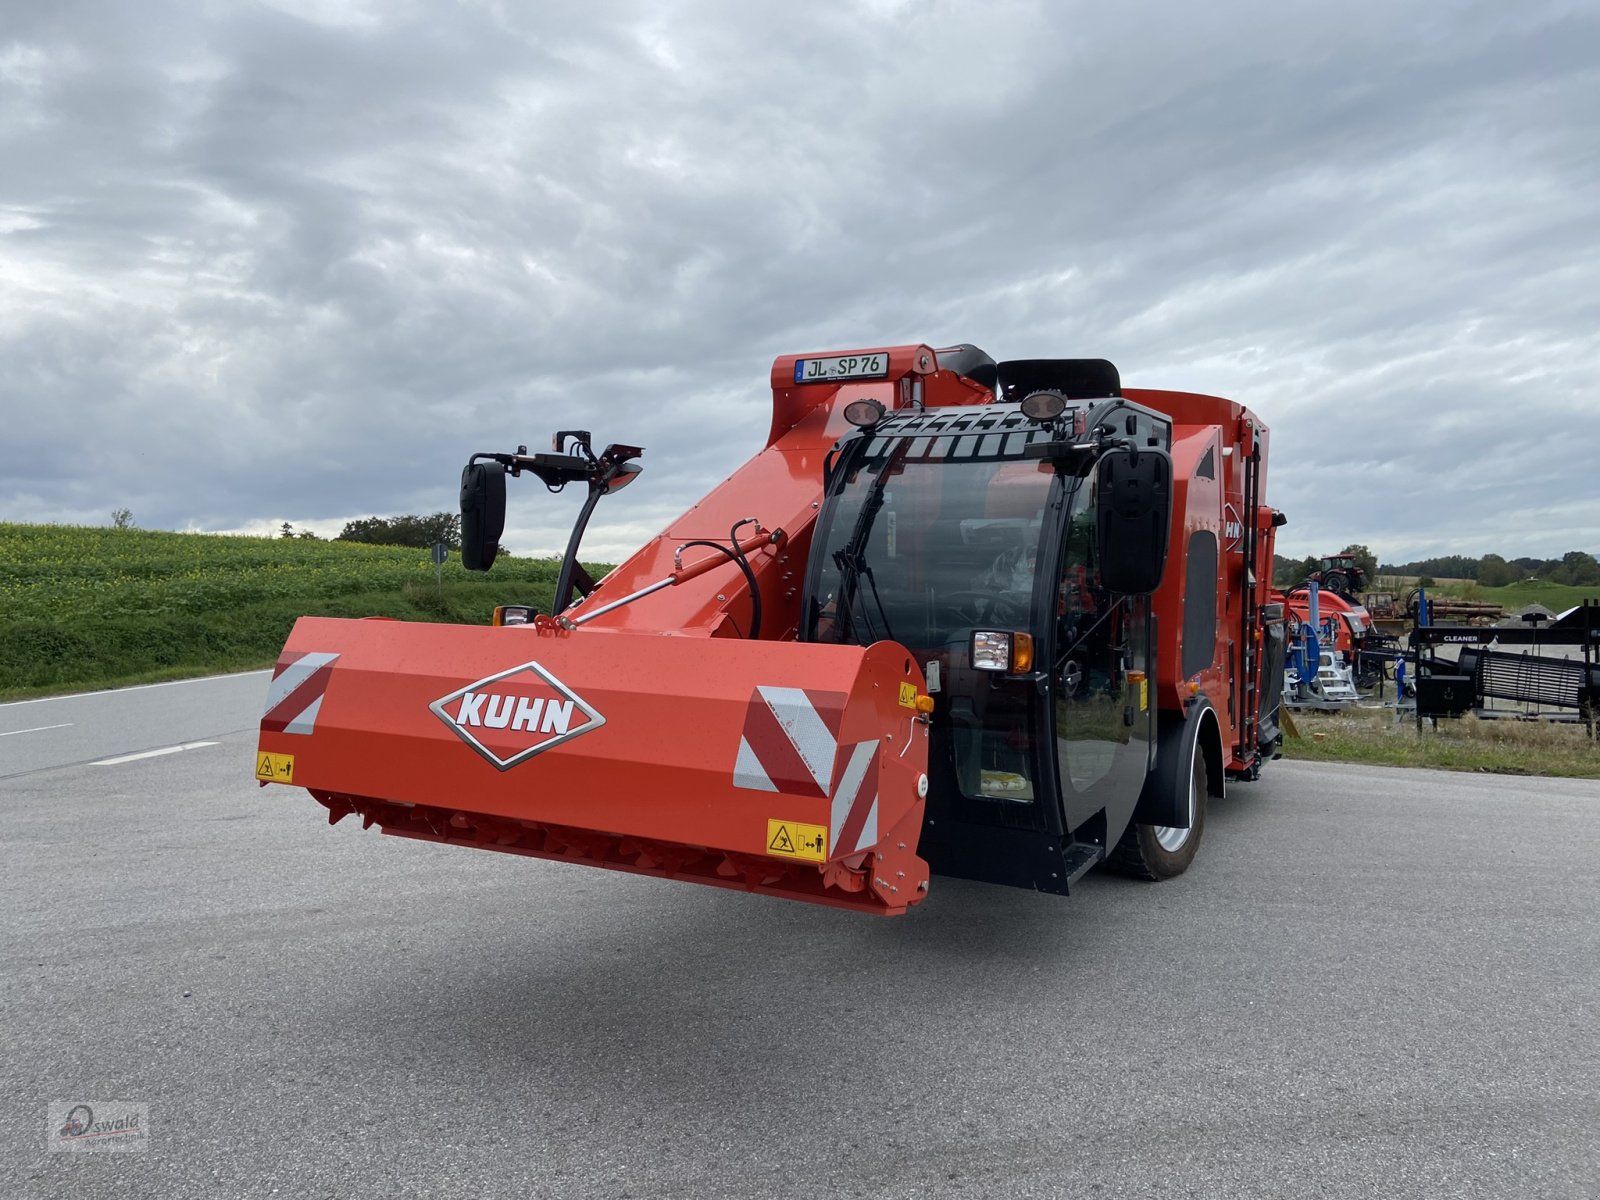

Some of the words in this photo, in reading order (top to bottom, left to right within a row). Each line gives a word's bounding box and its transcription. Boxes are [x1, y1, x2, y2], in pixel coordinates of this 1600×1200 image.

[808, 361, 827, 377] JL
[838, 358, 858, 375] SP
[861, 356, 880, 373] 76
[1225, 521, 1240, 538] HN
[456, 692, 575, 735] KUHN
